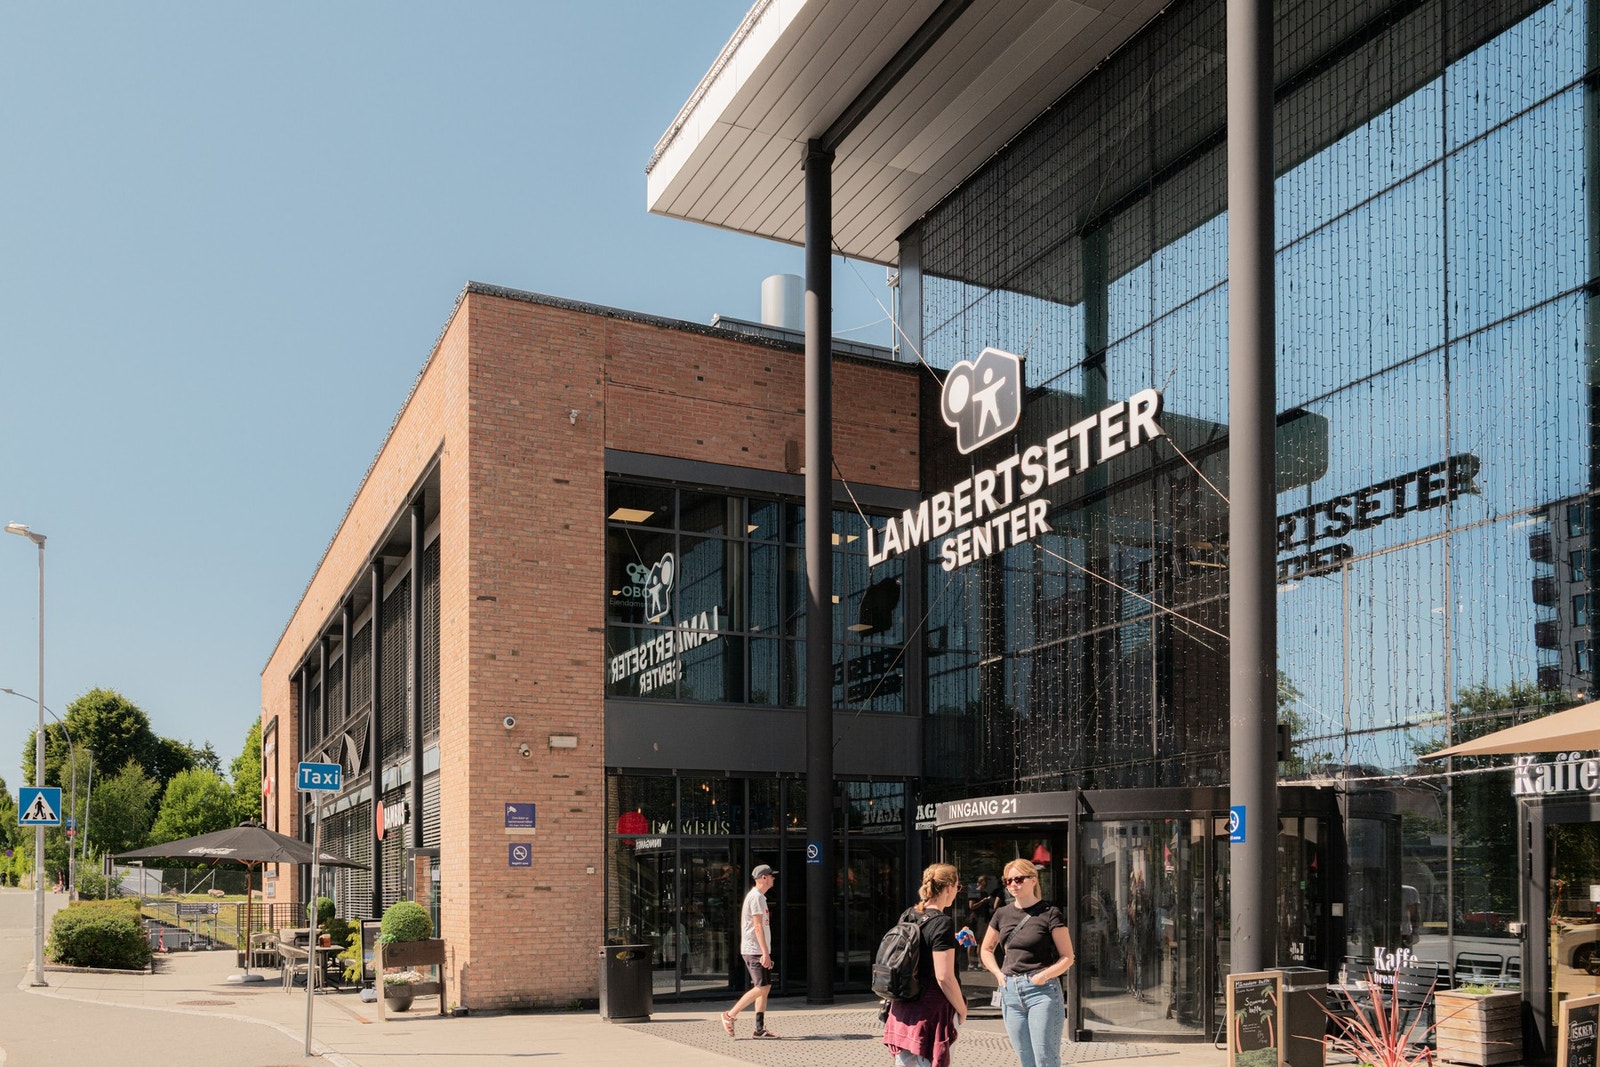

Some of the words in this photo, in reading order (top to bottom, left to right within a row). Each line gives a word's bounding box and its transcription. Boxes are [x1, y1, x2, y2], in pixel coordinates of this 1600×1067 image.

[867, 388, 1163, 568] LAMBERTSETER
[1276, 453, 1481, 553] RTSETER
[941, 499, 1051, 572] SENTER
[301, 768, 339, 785] Taxi
[1513, 752, 1600, 795] Kaffe
[948, 799, 998, 819] INNGANG
[1001, 798, 1017, 814] 21
[1373, 946, 1418, 971] Kaffe
